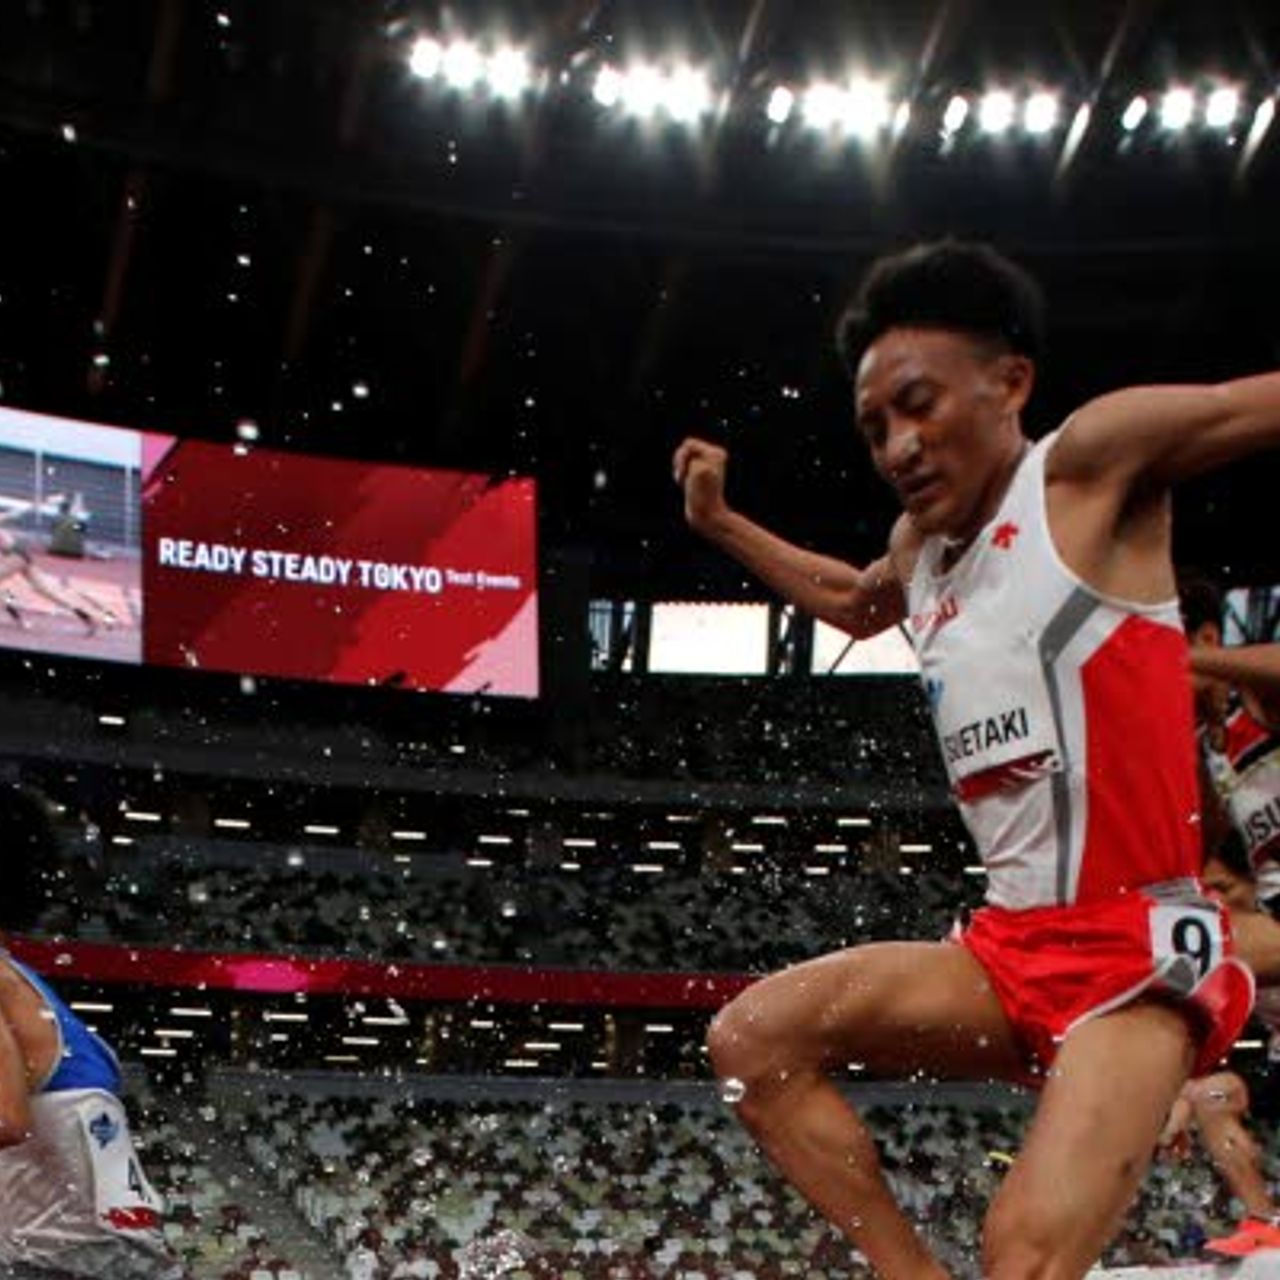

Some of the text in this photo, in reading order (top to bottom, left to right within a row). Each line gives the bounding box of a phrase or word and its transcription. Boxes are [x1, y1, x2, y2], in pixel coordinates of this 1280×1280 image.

[158, 536, 247, 573] READY
[251, 549, 354, 587] STEADY
[356, 559, 444, 594] TOKYO
[1171, 915, 1212, 978] 9
